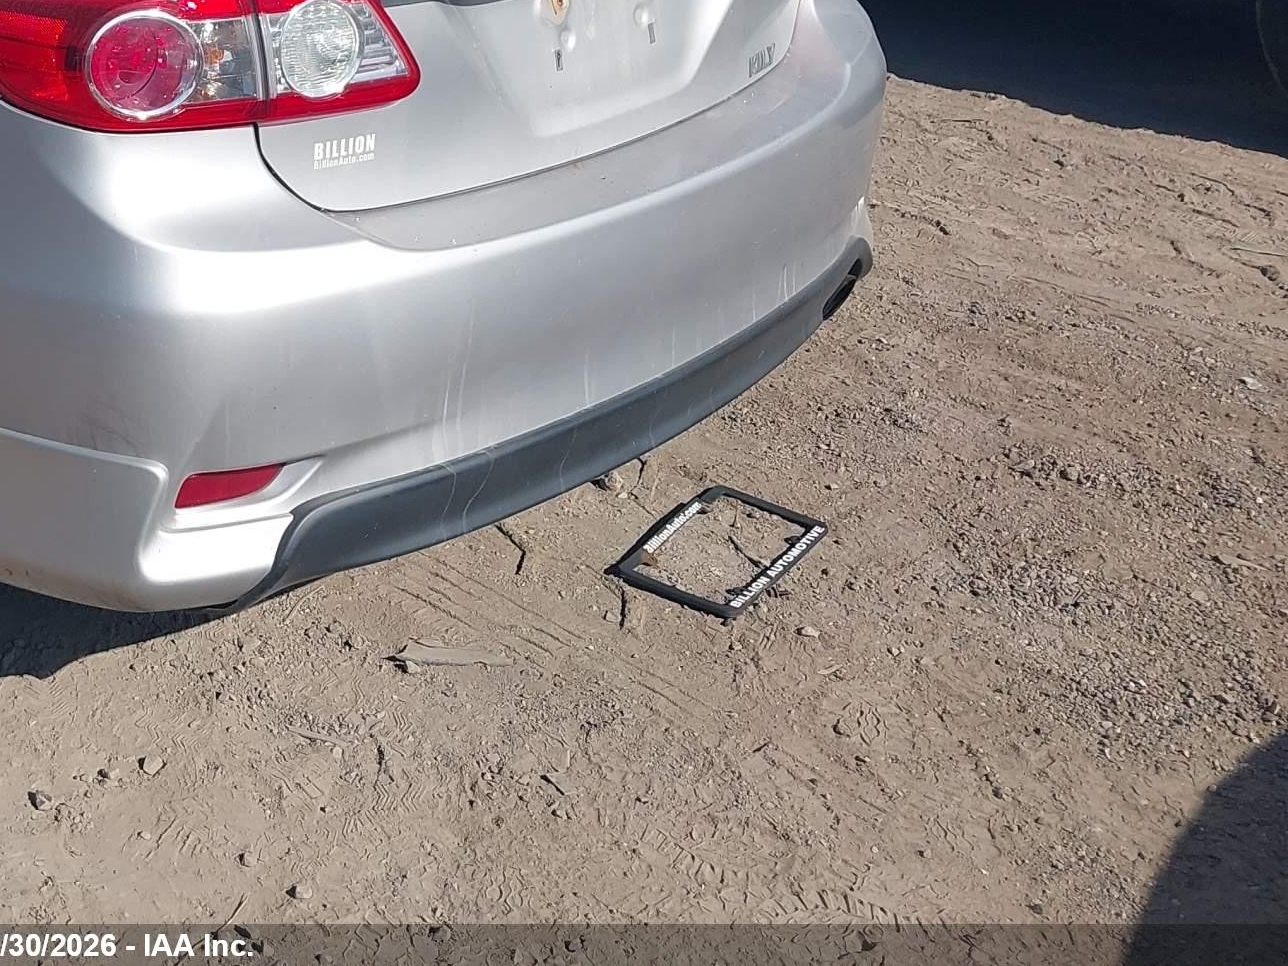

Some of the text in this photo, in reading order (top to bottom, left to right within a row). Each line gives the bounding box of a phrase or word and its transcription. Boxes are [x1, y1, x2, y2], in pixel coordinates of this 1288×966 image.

[313, 133, 376, 161] BILLION
[313, 153, 375, 170] BillionAuto.com
[729, 524, 826, 609] BILLION AUTOMOTIVE
